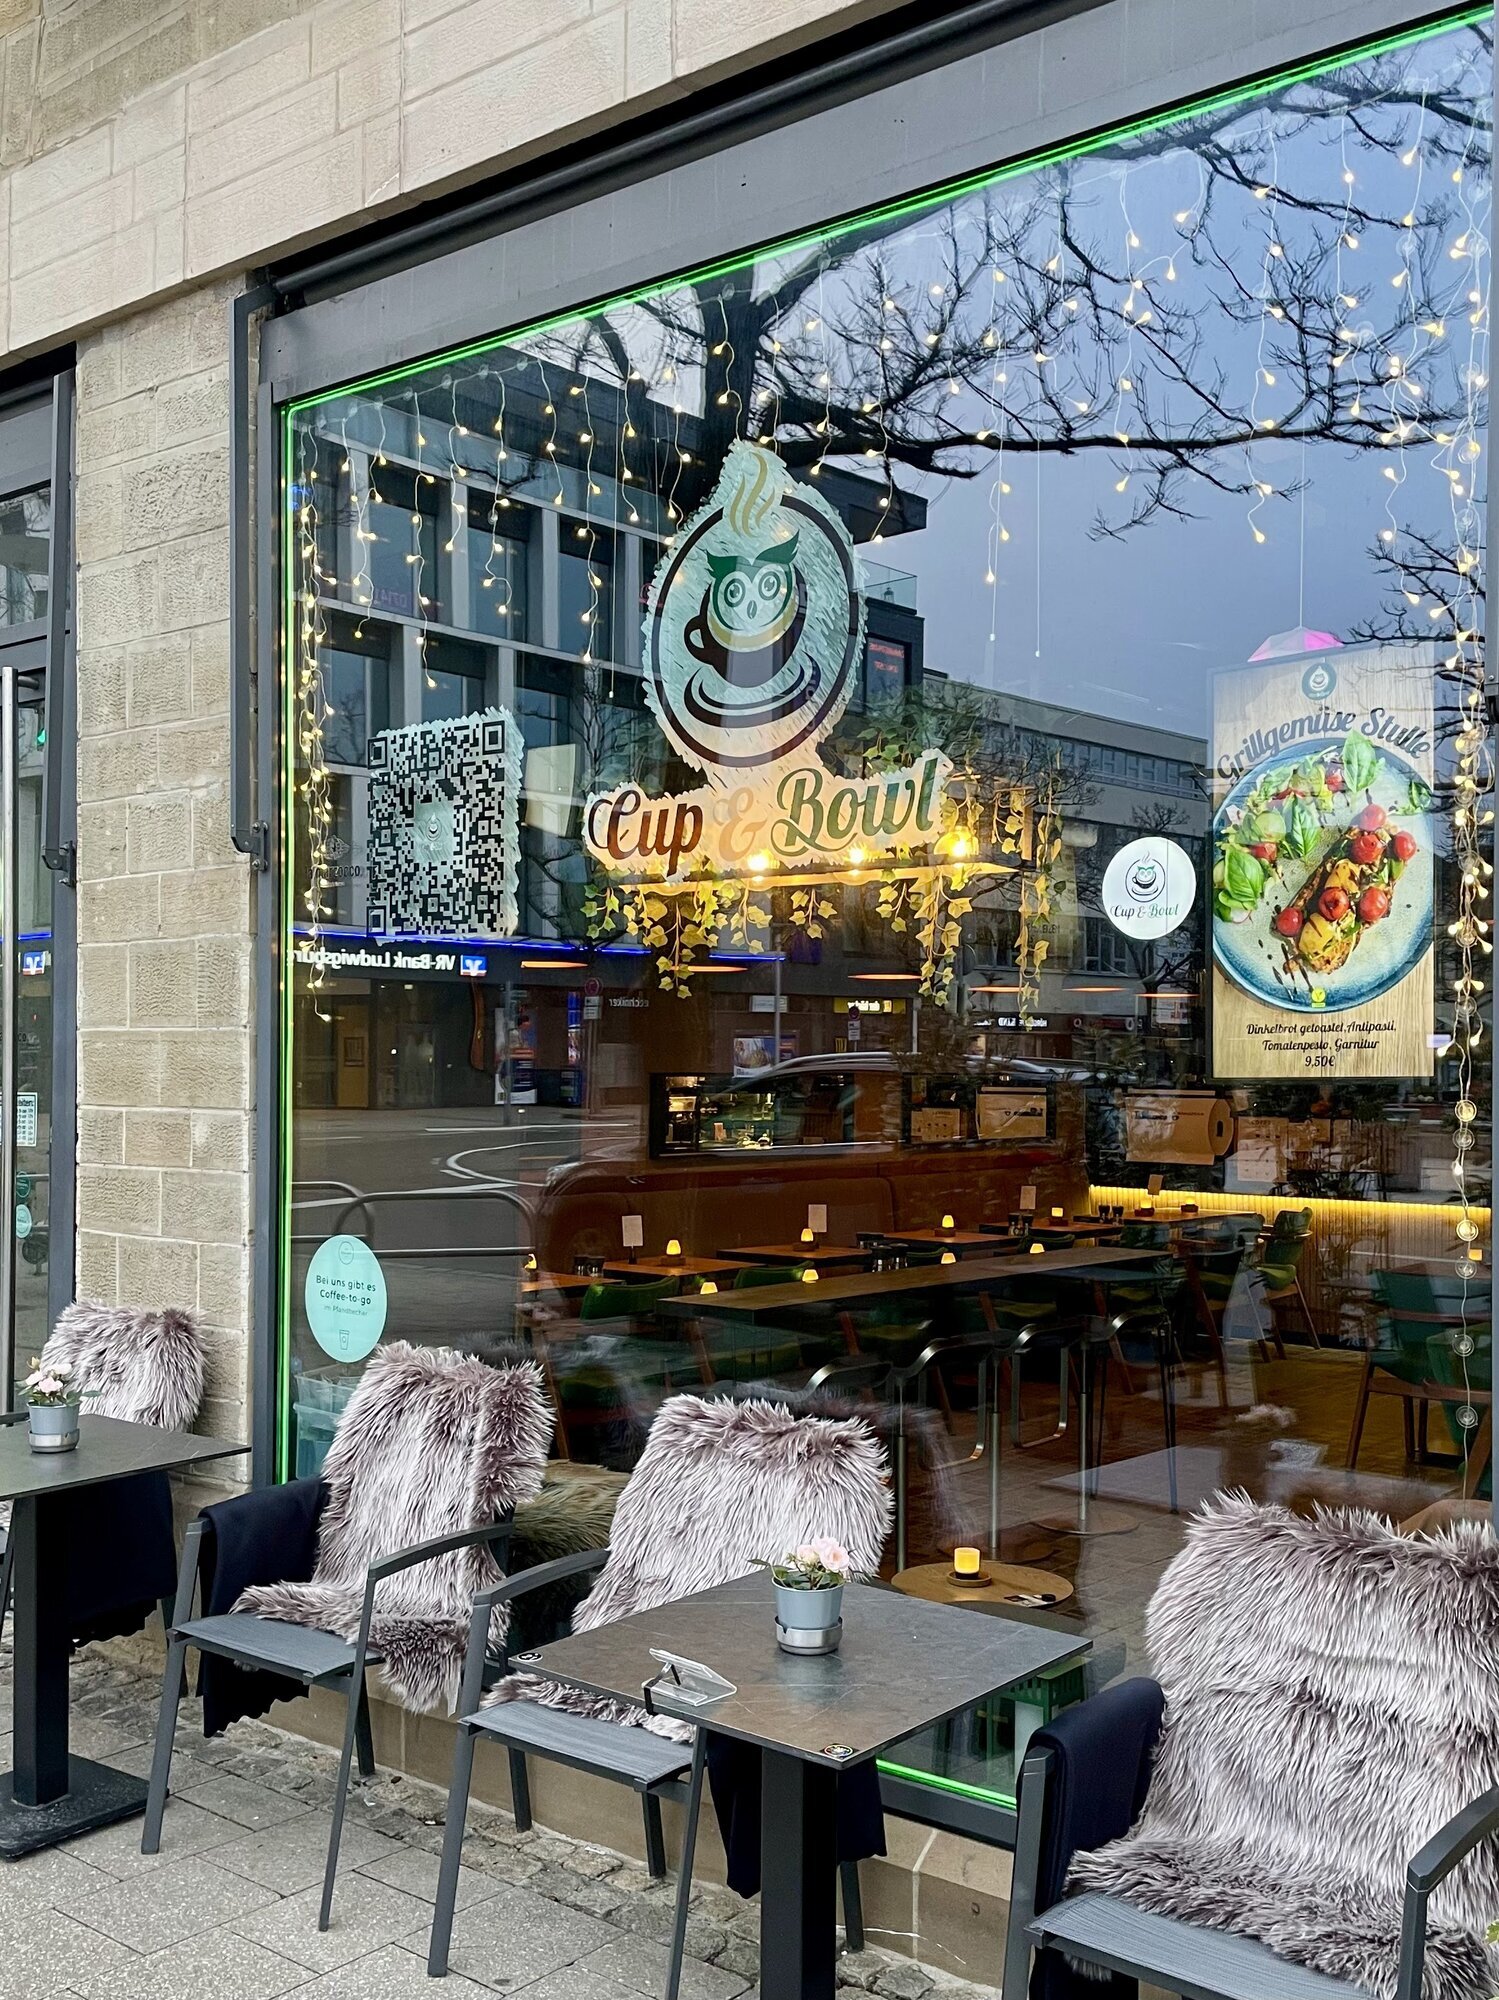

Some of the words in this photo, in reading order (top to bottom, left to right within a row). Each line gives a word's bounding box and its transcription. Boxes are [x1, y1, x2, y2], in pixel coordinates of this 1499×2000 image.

[1216, 706, 1356, 781] Grillgemüse
[1361, 707, 1431, 759] Stulle
[588, 789, 703, 877] Cup
[712, 787, 767, 862] &
[770, 757, 937, 857] Bowl
[1110, 904, 1134, 920] Cup
[1137, 905, 1147, 918] &
[1148, 903, 1179, 918] Bowl
[1246, 1024, 1297, 1035] Dinkelbrot
[1334, 1038, 1380, 1052] Garnitur
[1305, 1055, 1336, 1068] 9,50€
[316, 1275, 329, 1285] Bei
[331, 1279, 346, 1287] uns
[348, 1281, 365, 1290] gibt
[366, 1284, 377, 1292] es
[319, 1289, 372, 1306] Coffee-to-go
